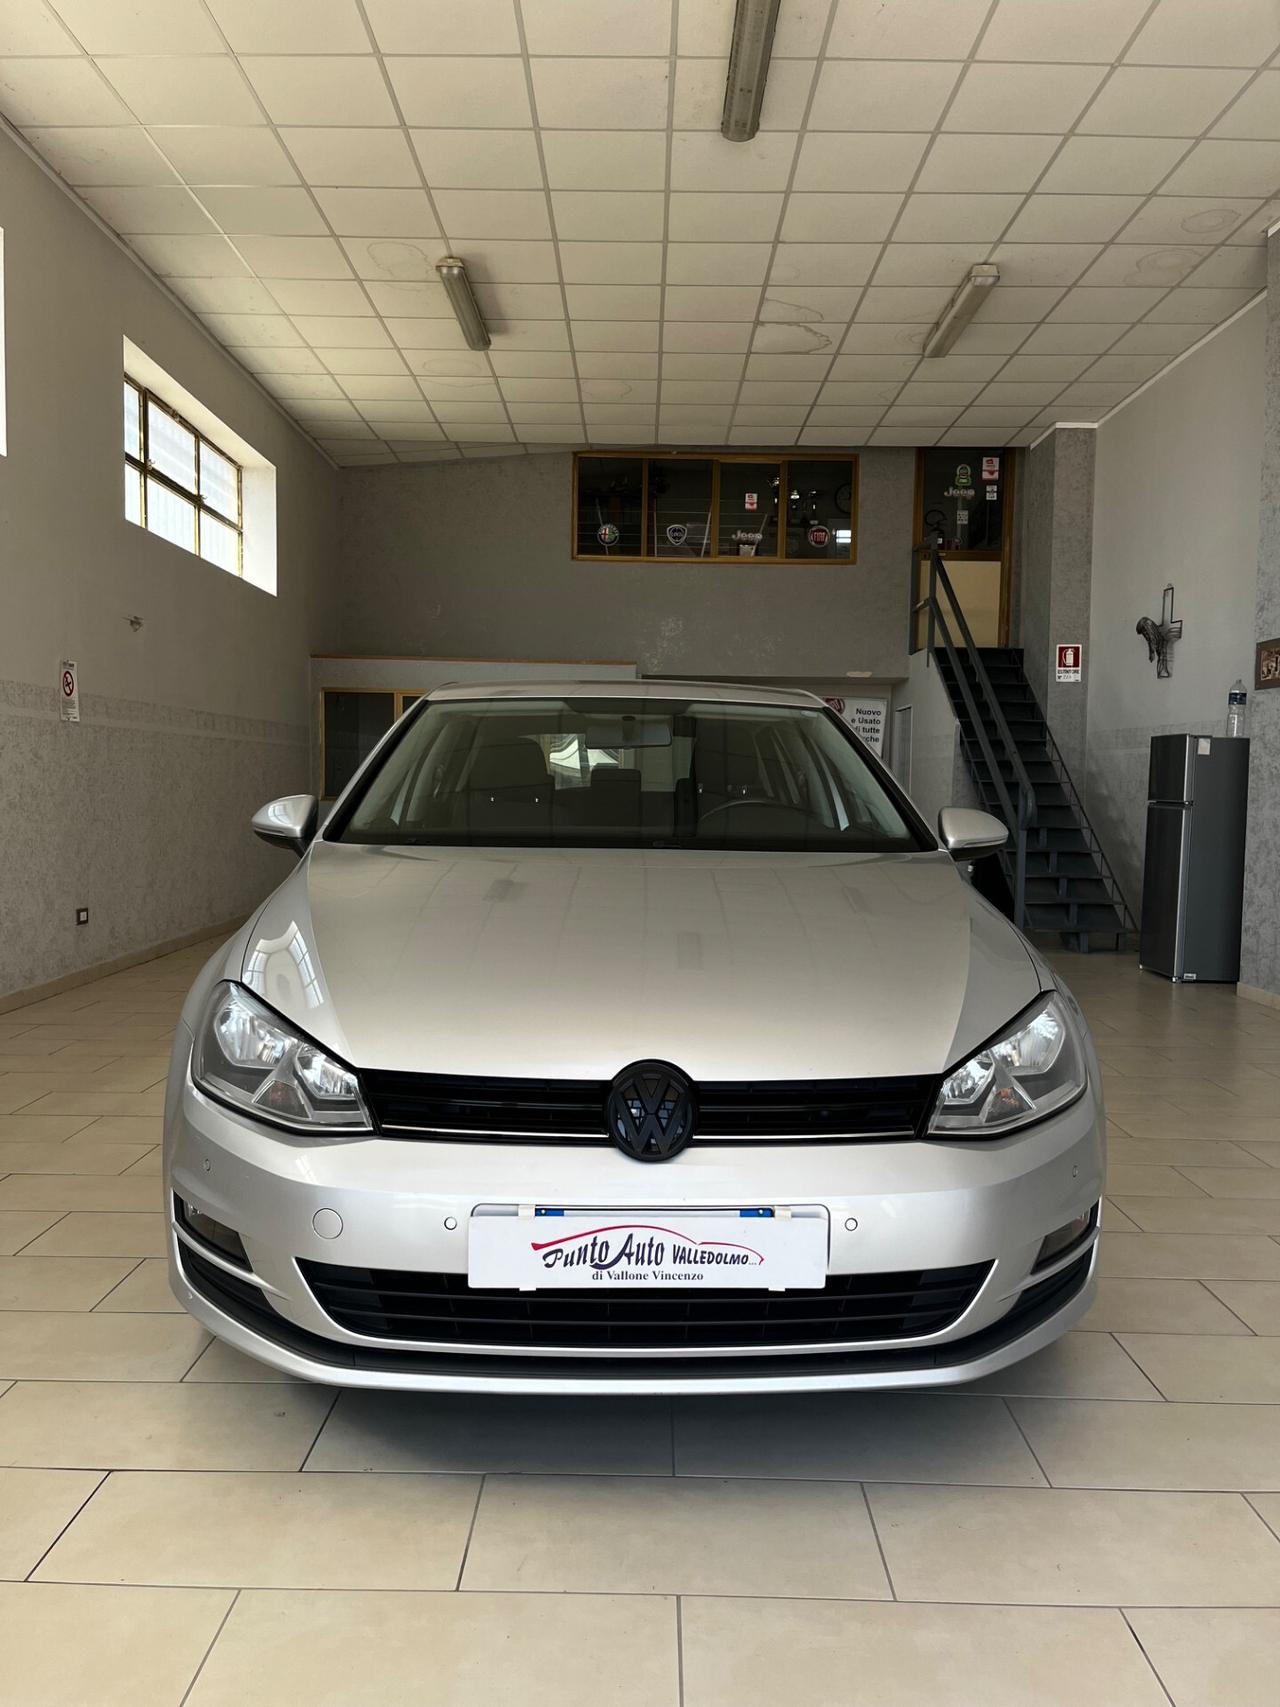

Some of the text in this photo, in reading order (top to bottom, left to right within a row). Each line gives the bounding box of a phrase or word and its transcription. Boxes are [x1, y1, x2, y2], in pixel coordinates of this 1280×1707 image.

[856, 708, 881, 716] Nuovo
[858, 717, 881, 725] Usato
[542, 1236, 610, 1269] Punto
[589, 1233, 666, 1270] Auto
[592, 1270, 704, 1282] di Vallone Vincenzo
